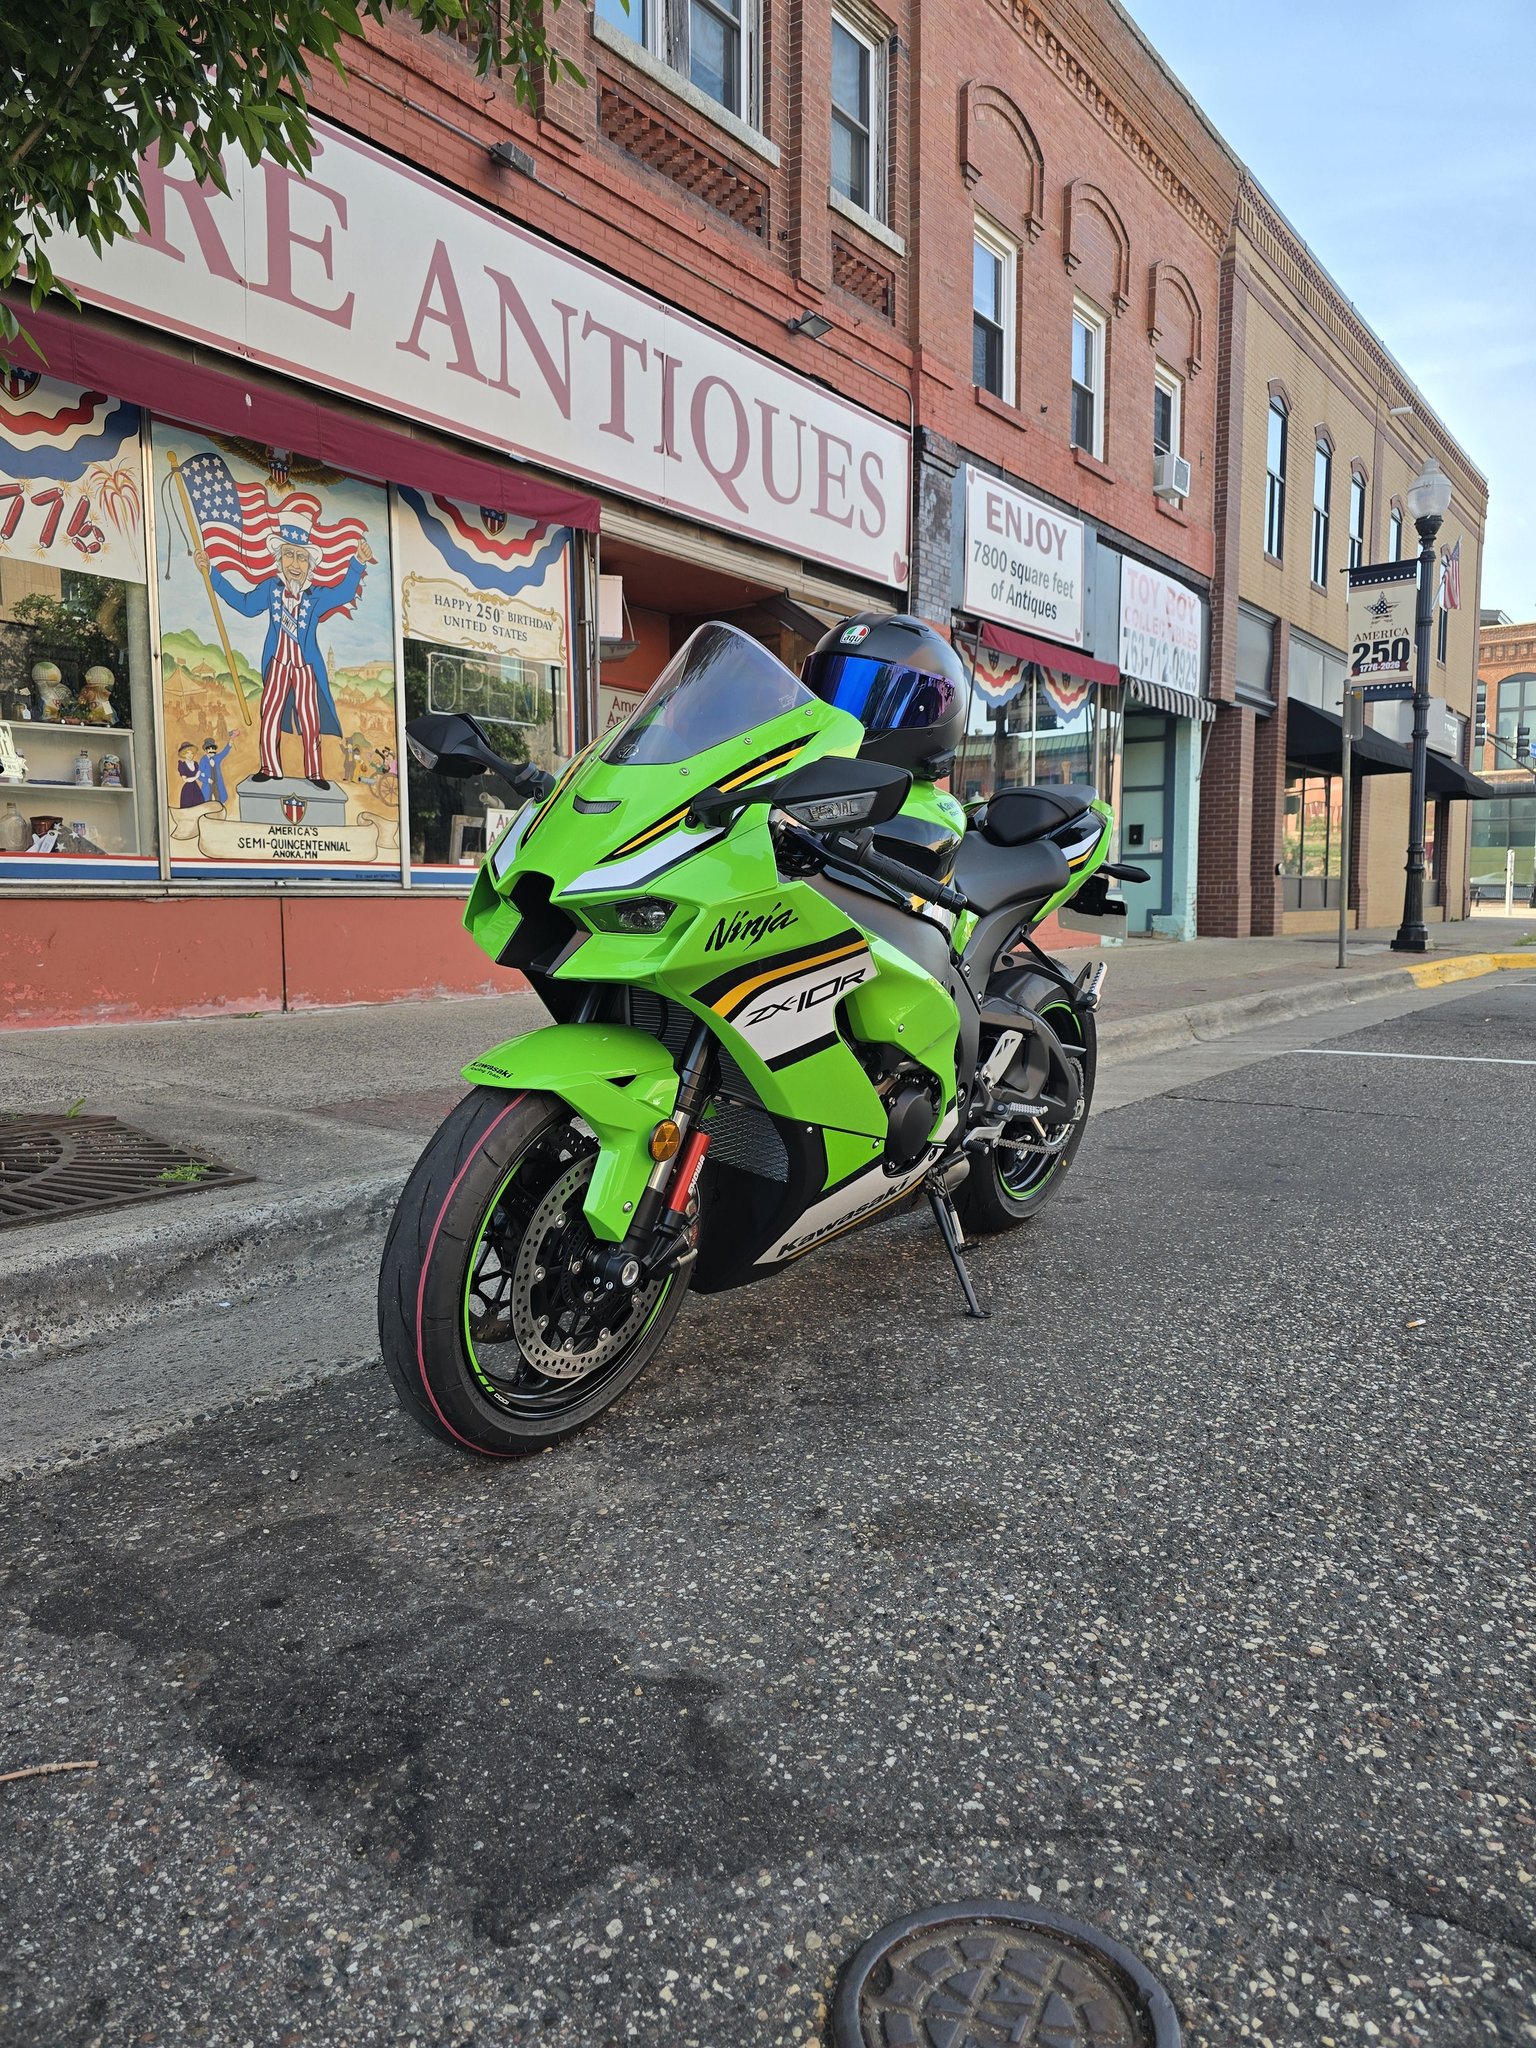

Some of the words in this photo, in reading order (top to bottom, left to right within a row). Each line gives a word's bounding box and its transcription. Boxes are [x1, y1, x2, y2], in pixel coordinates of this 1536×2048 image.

[396, 238, 887, 539] ANTIQUES
[986, 490, 1068, 562] ENJOY
[974, 539, 1008, 573] 7800
[1010, 559, 1050, 590] square
[1052, 571, 1075, 600] feet
[1127, 567, 1160, 610] TOY
[434, 594, 473, 613] HAPPY
[507, 611, 554, 631] BIRTHDAY
[991, 579, 1005, 602] of
[1005, 583, 1058, 621] Antiques
[443, 614, 487, 633] UNITED
[492, 625, 529, 642] STATES
[1353, 626, 1410, 643] AMERICA
[1351, 637, 1411, 671] 250
[1359, 660, 1401, 673] 1776-2026
[237, 837, 351, 852] SEMI-QUINCENTENNIAL
[268, 825, 319, 837] AMERICA'S
[704, 901, 799, 953] Ninja
[743, 967, 867, 1028] ZX-10R
[470, 1061, 514, 1079] Kawasaki
[776, 1175, 911, 1258] Kawasaki
